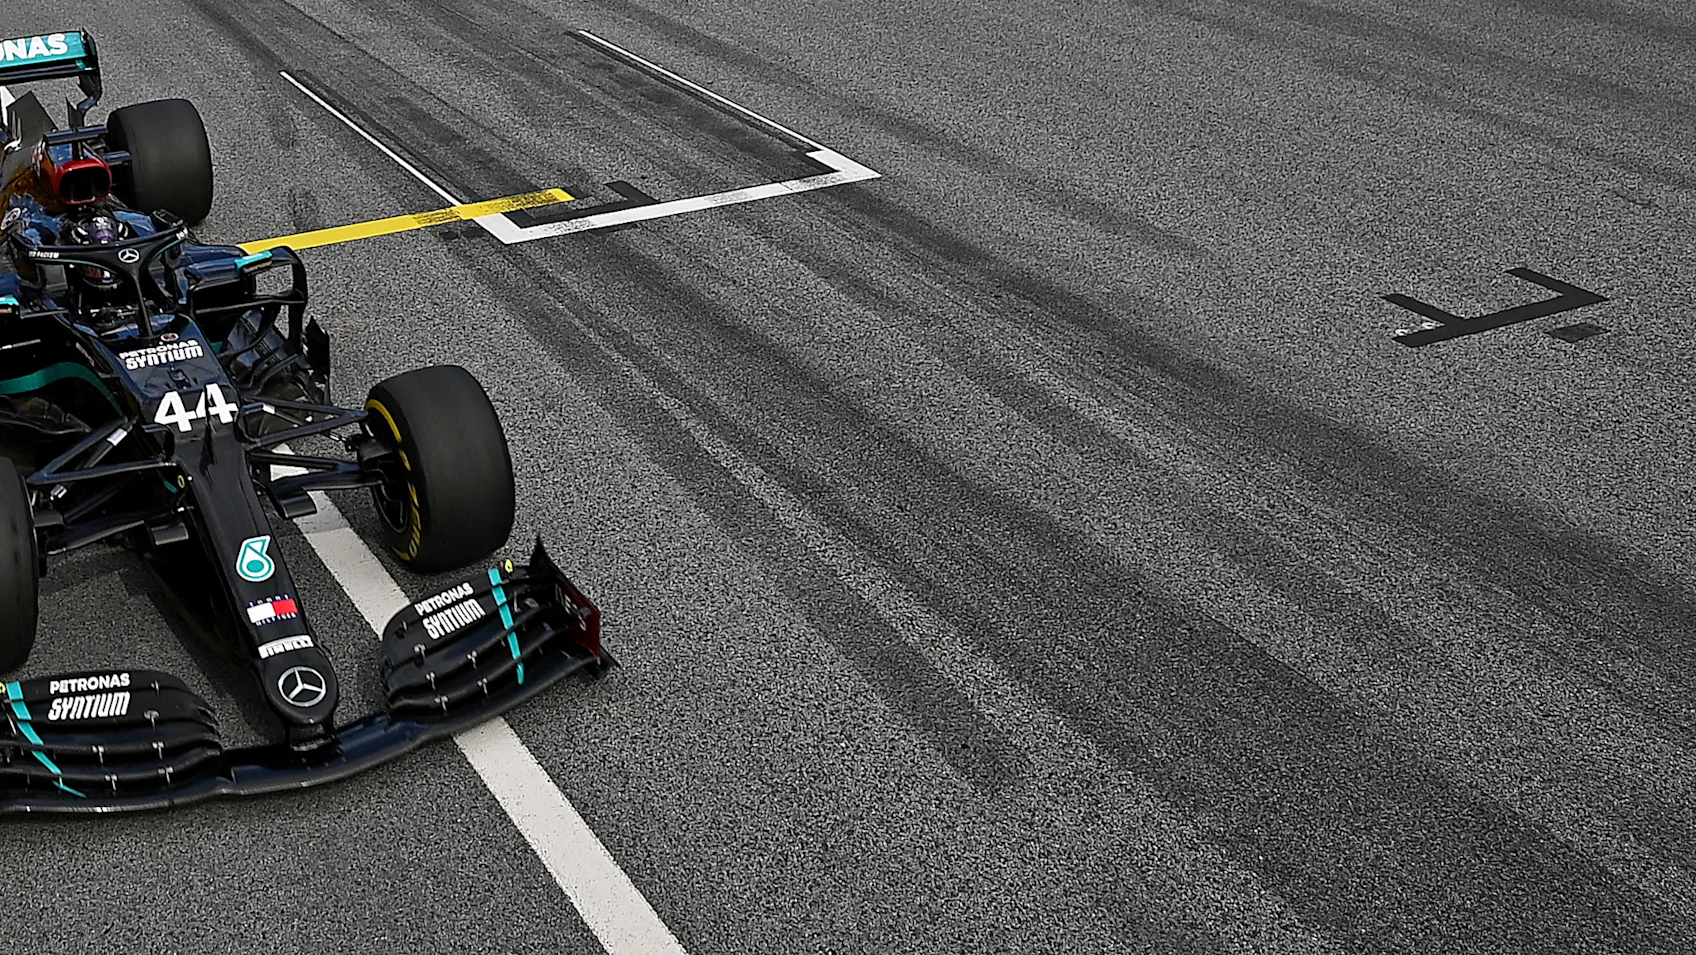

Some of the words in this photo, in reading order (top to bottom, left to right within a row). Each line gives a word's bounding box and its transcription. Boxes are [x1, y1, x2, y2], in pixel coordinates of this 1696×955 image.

[119, 340, 199, 359] PETRONAS
[126, 346, 203, 370] SYNTIUM
[154, 383, 239, 432] 44
[414, 582, 474, 617] PETRONAS
[422, 598, 486, 640] SYNTIUM
[258, 634, 314, 659] PIRELLI
[50, 673, 131, 695] PETRONAS
[47, 691, 131, 721] SYNTIUM
